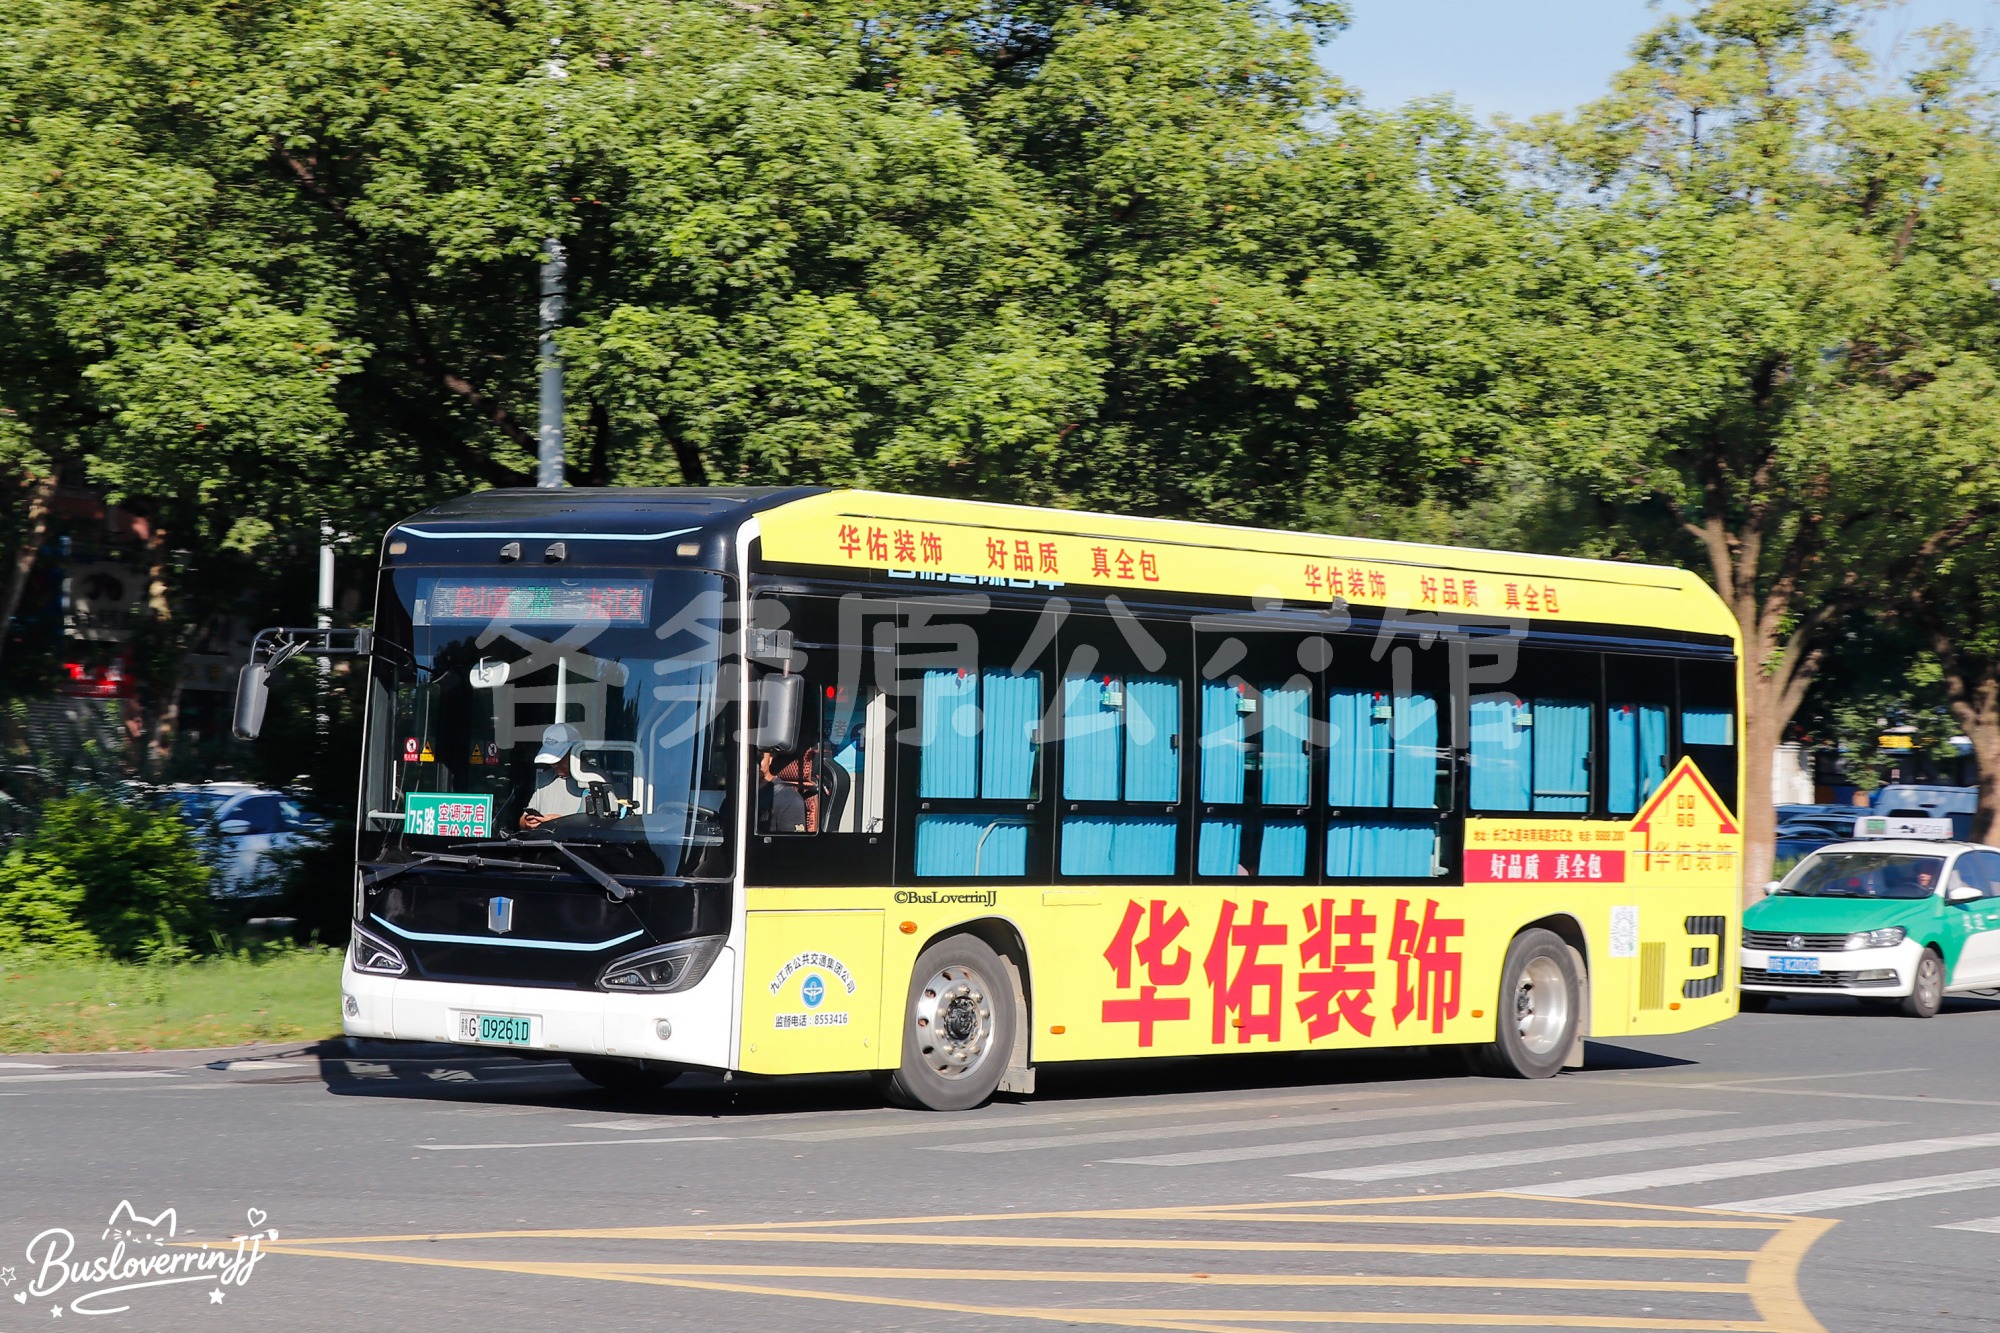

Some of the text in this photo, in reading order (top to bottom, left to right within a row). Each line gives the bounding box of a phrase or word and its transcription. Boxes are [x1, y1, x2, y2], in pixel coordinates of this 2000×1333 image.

[838, 524, 943, 565] 华佑装饰
[986, 537, 1059, 575] 好品质
[1091, 547, 1160, 582] 真全包
[1304, 564, 1560, 613] 华佑装饰 好品质 真全包
[409, 807, 435, 835] 75路
[439, 803, 486, 822] 空调开启
[1490, 853, 1603, 879] 好品质 真全包
[1655, 841, 1734, 872] 华佑装饰
[770, 953, 856, 994] 九江市公共交通集团公司
[1101, 898, 1465, 1048] 华佑装饰
